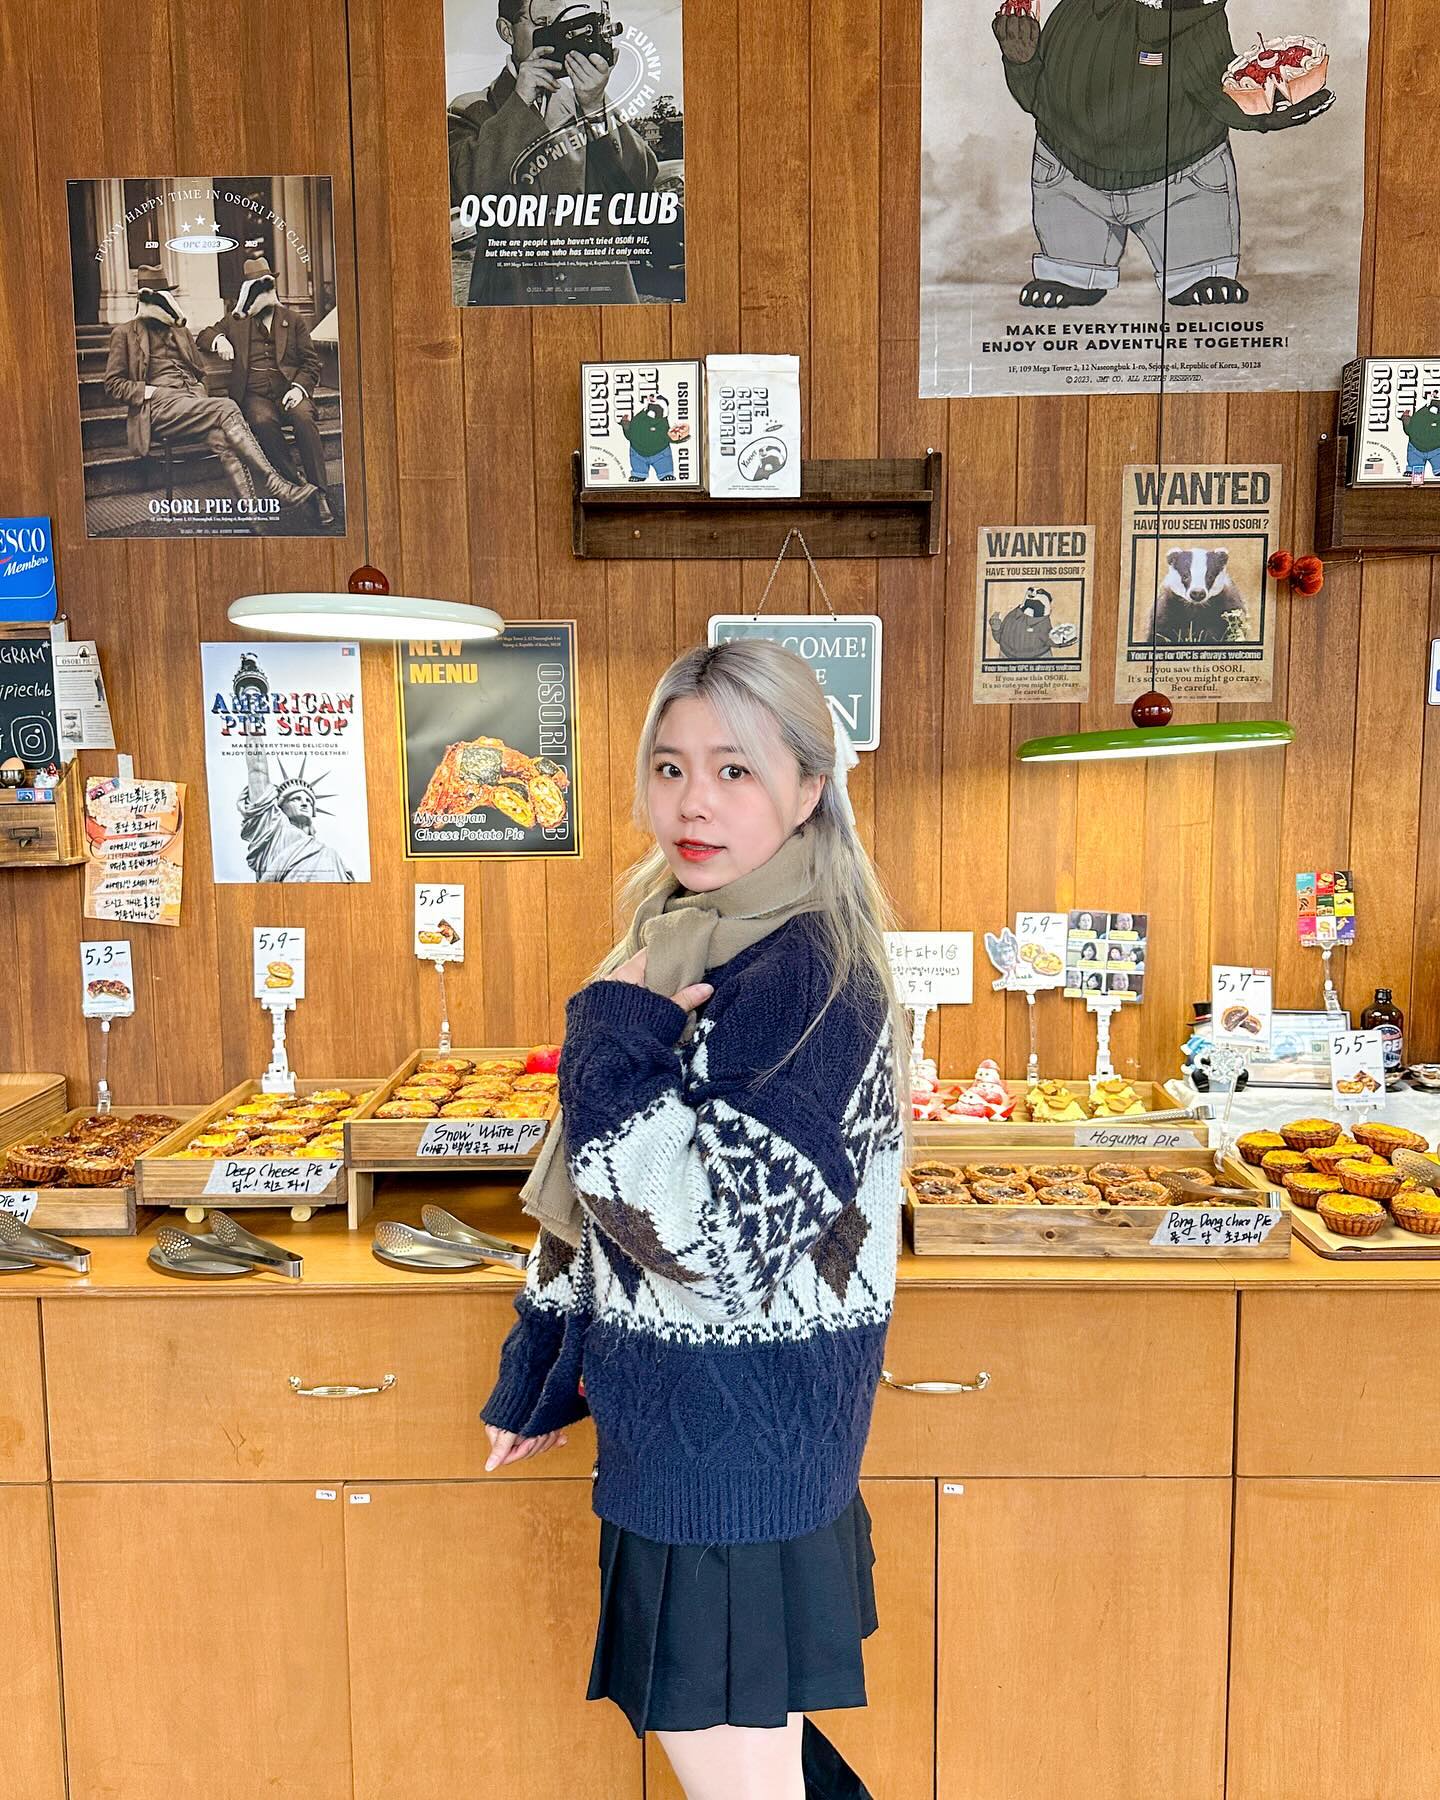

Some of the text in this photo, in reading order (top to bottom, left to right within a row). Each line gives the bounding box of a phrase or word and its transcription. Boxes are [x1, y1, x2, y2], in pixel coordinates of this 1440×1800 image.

[626, 25, 662, 82] FUNNY
[610, 84, 655, 130] HAPPY
[521, 155, 547, 185] OPC
[459, 192, 679, 228] OSORI PIE CLUB
[94, 189, 312, 264] FUNNY HAPPY TIME IN OSORI PIE CLUB
[485, 249, 498, 257] but
[499, 249, 523, 257] there's
[551, 248, 568, 256] who
[568, 248, 582, 256] has
[584, 248, 607, 256] tasted
[608, 247, 615, 255] it
[615, 247, 632, 256] only
[633, 247, 653, 255] once.
[487, 236, 650, 248] There are people who haven't tried OSORI PIE,
[1006, 321, 1265, 336] MAKE EVERYTHING DELICIOUS
[982, 337, 1290, 353] ENJOY OUR ADVENTURE TOGETHER!
[1019, 365, 1032, 373] 109
[1032, 365, 1051, 374] Mega
[1052, 364, 1072, 372] Tower
[1180, 362, 1209, 372] Republic
[1210, 361, 1218, 369] of
[1218, 361, 1240, 370] Korea,
[1241, 361, 1262, 369] 30128
[589, 368, 610, 438] OSORI
[678, 381, 689, 421] OSORI
[753, 387, 769, 418] PIE
[1368, 363, 1392, 433] OSORI
[719, 386, 736, 445] OSORI
[736, 387, 752, 436] CLUB
[678, 447, 690, 481] CLUB
[1134, 471, 1271, 506] WANTED
[1134, 519, 1159, 530] HAVE
[1161, 519, 1181, 530] YOU
[1182, 519, 1208, 530] SEEN
[1210, 518, 1231, 530] THIS
[986, 531, 1087, 558] WANTED
[3, 555, 49, 577] Members
[985, 567, 1005, 576] HAVE
[1006, 567, 1021, 576] YOU
[1022, 567, 1041, 576] SEEN
[1041, 566, 1057, 575] THIS
[408, 639, 463, 657] NEW
[1130, 651, 1148, 660] Your
[1164, 651, 1176, 660] for
[1176, 651, 1191, 660] OPC
[1192, 650, 1199, 659] is
[1199, 650, 1227, 661] always
[1228, 650, 1262, 659] welcome
[409, 663, 479, 684] MENU
[1128, 675, 1142, 683] It's
[1175, 677, 1192, 686] you
[1194, 674, 1221, 686] might
[1223, 676, 1234, 685] go
[1236, 676, 1262, 684] crazy.
[1155, 666, 1171, 675] you
[1192, 665, 1210, 673] this
[1171, 684, 1218, 692] Be careful.
[211, 692, 355, 714] AMERICAN
[537, 662, 567, 757] OSORI
[220, 715, 348, 736] PIE SHOP
[413, 812, 487, 828] Myeongran
[415, 827, 525, 841] Cheese Potato Pie
[908, 980, 932, 993] 5.9
[433, 1124, 541, 1142] Snow White Pie
[1090, 1130, 1148, 1147] Hoguma
[452, 1141, 492, 1156] 백설공주
[497, 1142, 519, 1154] 파이
[225, 1162, 256, 1182] Deep
[259, 1163, 300, 1178] Cheese
[263, 1180, 284, 1193] 치즈
[287, 1179, 310, 1192] 파이
[1168, 1212, 1197, 1236] Pong
[1200, 1213, 1223, 1233] Dang
